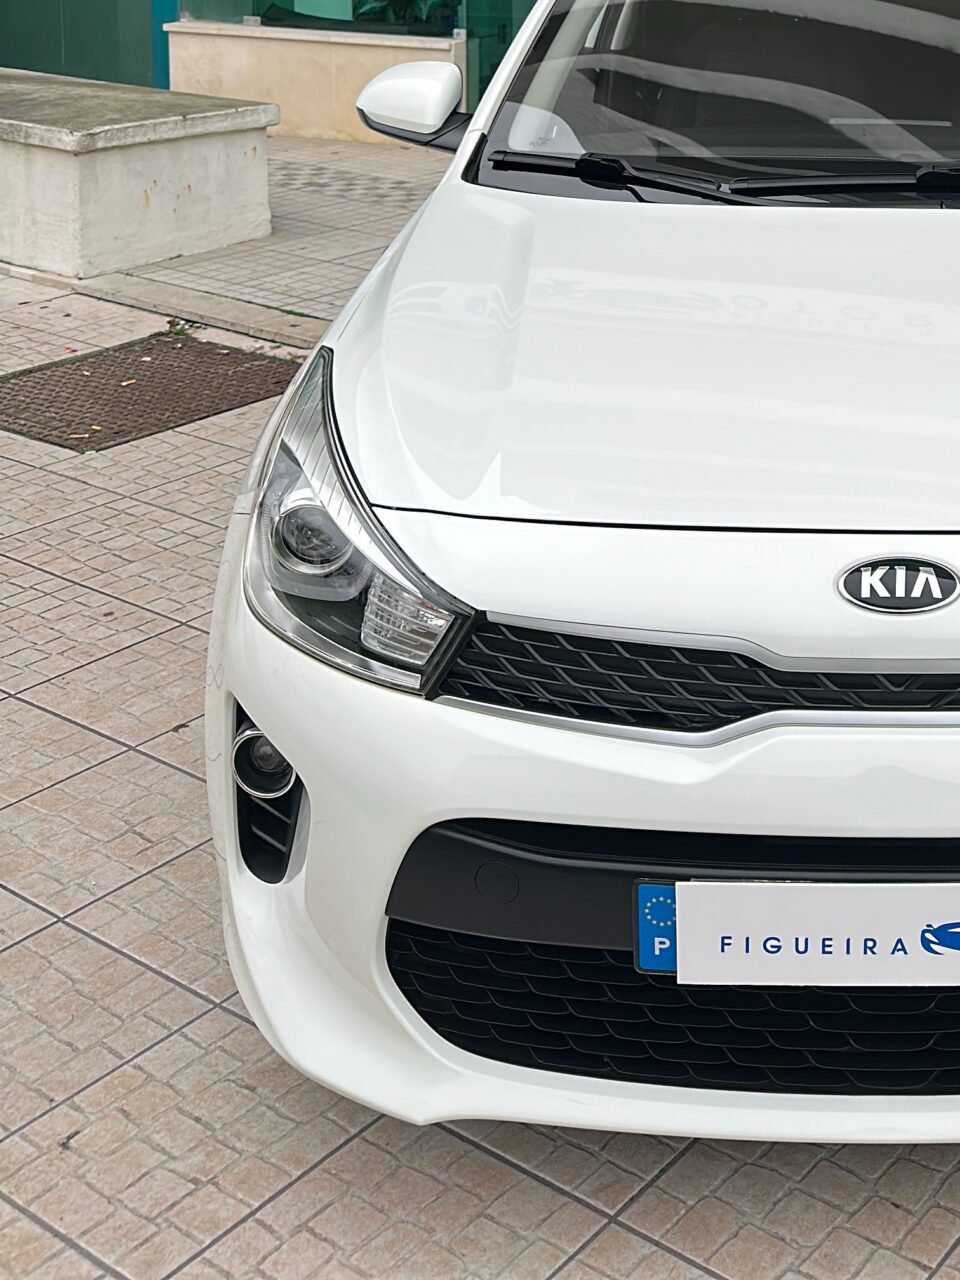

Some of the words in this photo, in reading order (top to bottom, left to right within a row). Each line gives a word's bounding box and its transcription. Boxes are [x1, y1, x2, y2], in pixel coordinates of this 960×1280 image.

[859, 565, 944, 599] KIA
[654, 937, 671, 956] P
[720, 935, 909, 957] FIGUEIRA
